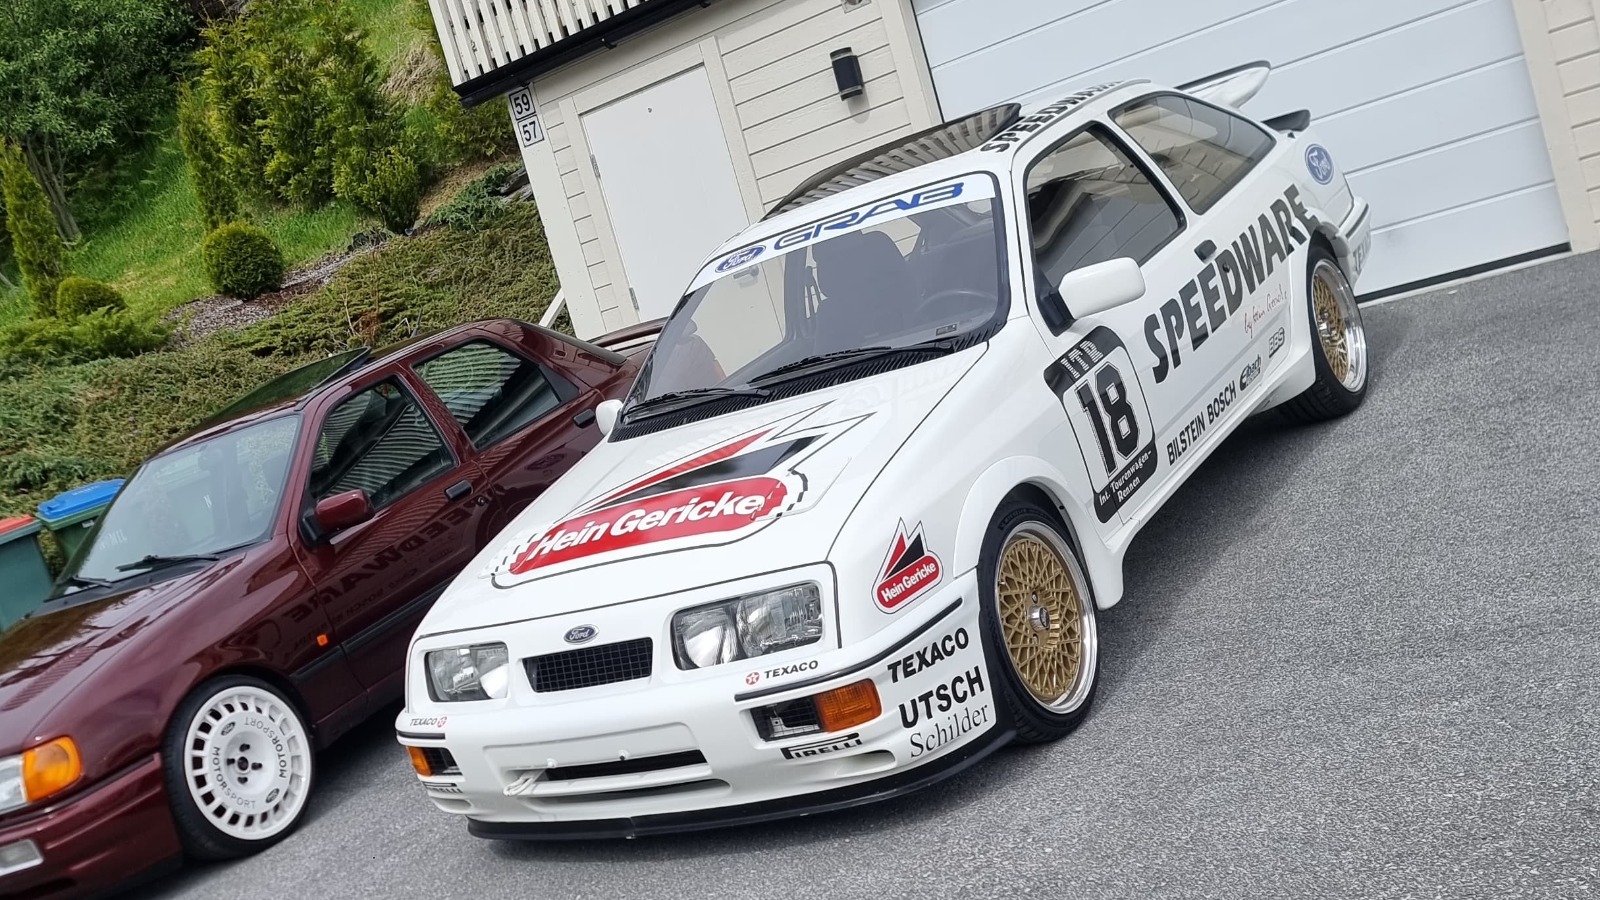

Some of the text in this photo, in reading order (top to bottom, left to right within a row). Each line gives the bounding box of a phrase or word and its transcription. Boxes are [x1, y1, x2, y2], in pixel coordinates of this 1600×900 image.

[513, 93, 531, 115] 59
[522, 121, 537, 142] 57
[774, 182, 965, 251] GRAB
[718, 246, 763, 272] Ford
[1144, 184, 1320, 384] SPEEDWARE
[1268, 326, 1286, 359] BBS
[1075, 362, 1140, 478] 18
[1166, 381, 1237, 466] BILSTEIN BOSCH
[1098, 450, 1152, 507] Int. Tourenwagen-
[1117, 475, 1141, 503] Rennen
[526, 490, 766, 562] Hein Gericke
[881, 561, 937, 603] Hein Gericke
[565, 625, 595, 643] Ford
[887, 626, 970, 684] TEXACO
[764, 660, 819, 680] TEXACO
[899, 664, 986, 729] UTSCH
[244, 717, 288, 779] MOTORSPORT
[409, 717, 438, 727] TEXACO
[780, 732, 863, 760] PIRELLI
[910, 704, 989, 758] Schilder
[212, 746, 256, 809] MOTORSPORT
